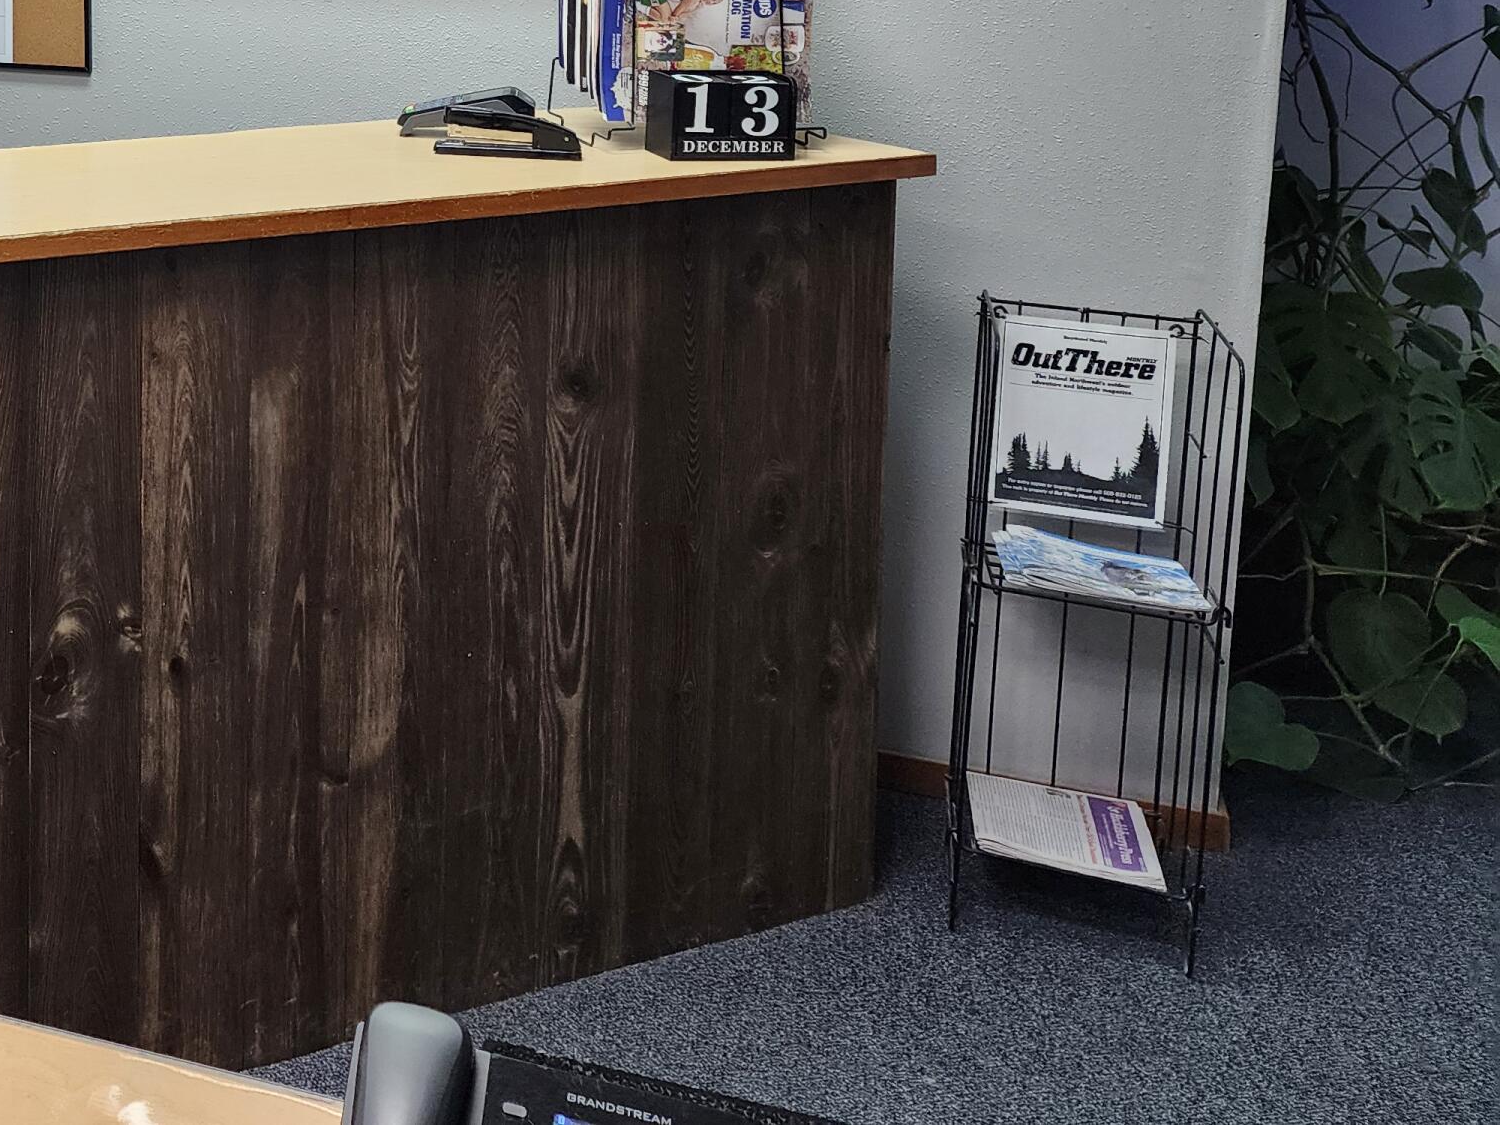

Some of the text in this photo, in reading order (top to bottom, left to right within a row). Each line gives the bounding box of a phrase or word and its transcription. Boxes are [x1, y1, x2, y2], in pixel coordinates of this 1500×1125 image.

[683, 140, 785, 153] DECEMBER
[1031, 379, 1062, 388] adventure
[1076, 383, 1101, 393] lifestyle
[1048, 374, 1068, 382] Inland
[1069, 377, 1106, 386] Northwest's
[1107, 381, 1131, 389] outdoor
[566, 1092, 672, 1125] GRANDSTREAM
